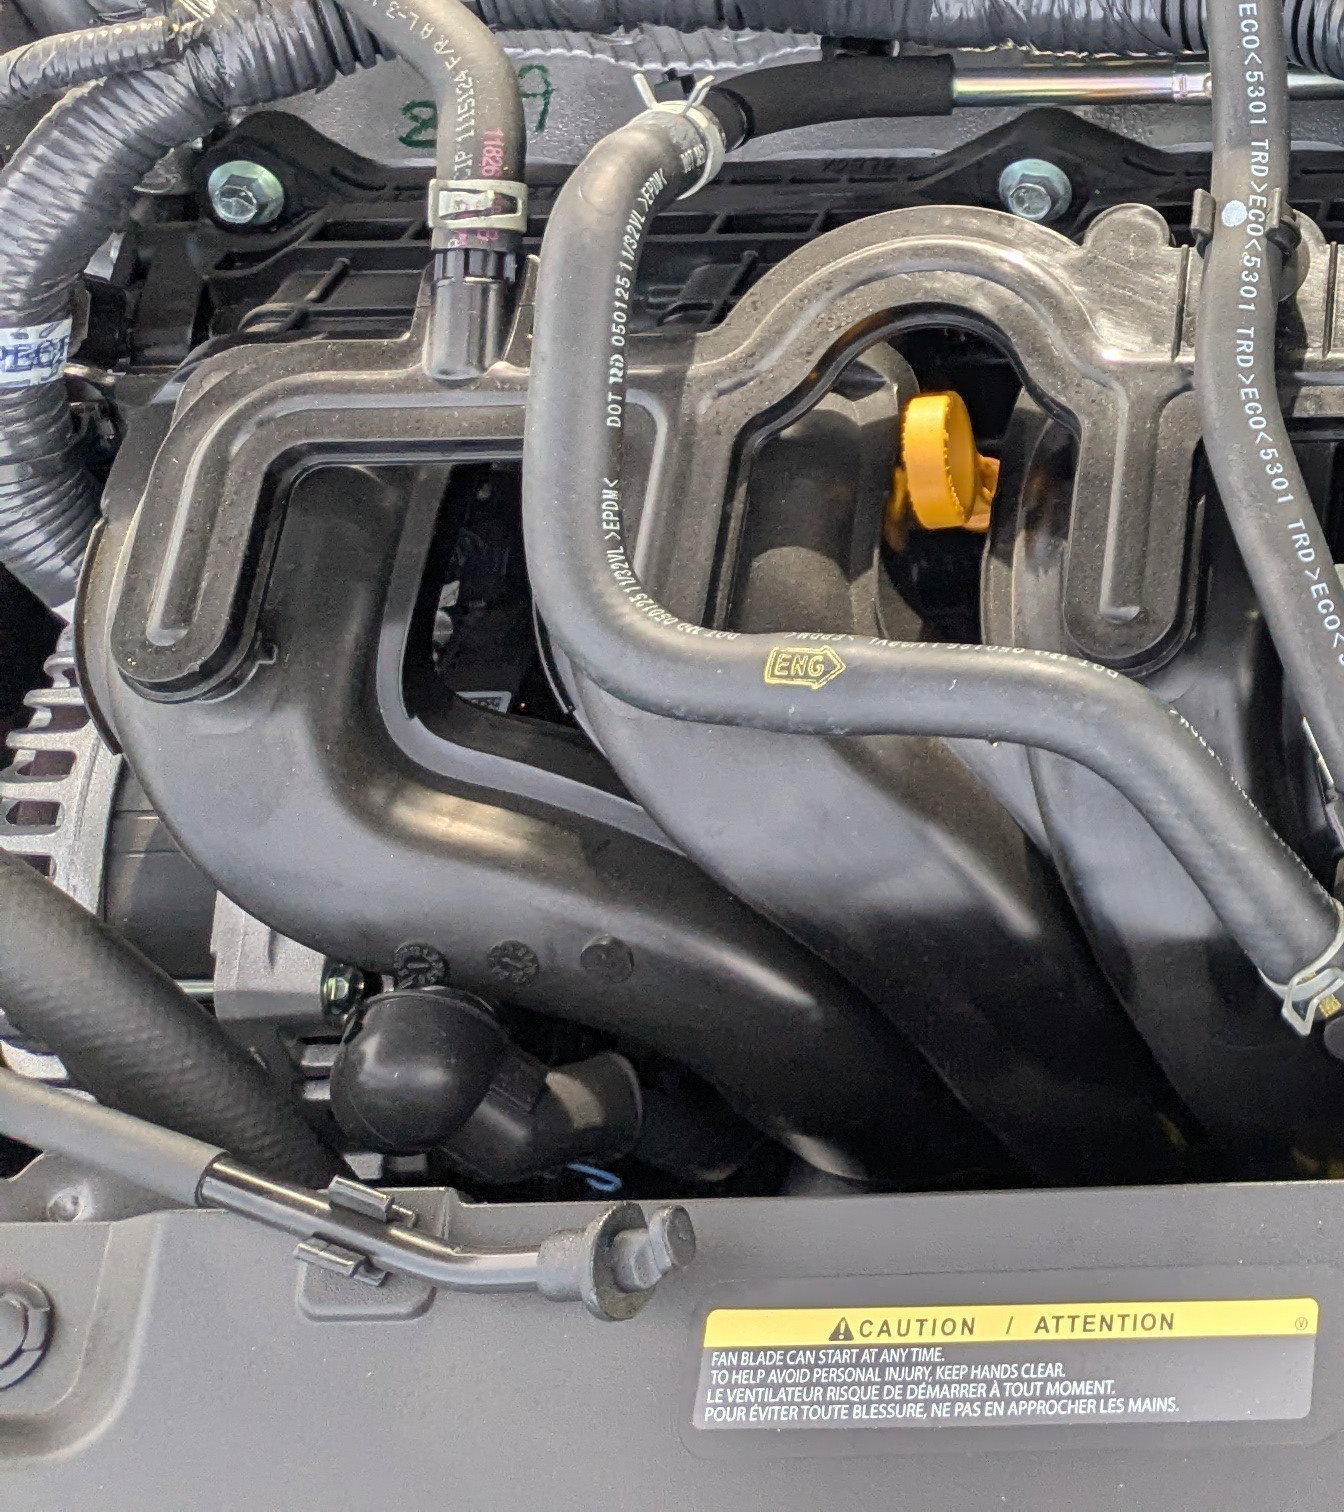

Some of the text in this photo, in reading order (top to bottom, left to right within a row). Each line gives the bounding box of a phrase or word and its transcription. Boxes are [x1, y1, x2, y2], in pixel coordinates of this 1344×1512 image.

[611, 275, 631, 347] 050125
[607, 391, 622, 428] DOT
[602, 477, 621, 542] >EPDM<
[629, 592, 678, 626] 050125
[774, 655, 824, 676] ENG
[859, 1317, 976, 1338] CAUTION
[1034, 1313, 1175, 1334] ATTENTION
[711, 1347, 945, 1366] FAN BLADE CAN START AT ANY TIME.
[710, 1363, 1066, 1384] TO HELP AVOID PERSONAL INJURY, KEEP HANDS CLEAR.
[707, 1380, 1116, 1403] LE VENTILATEUR RISQUE DE DÉMARRER À TOUT MOMENT.
[704, 1397, 1180, 1422] POUR ÉVITER TOUTE BLESSURE, NE PAS EN APPROCHER LES MAINS.
